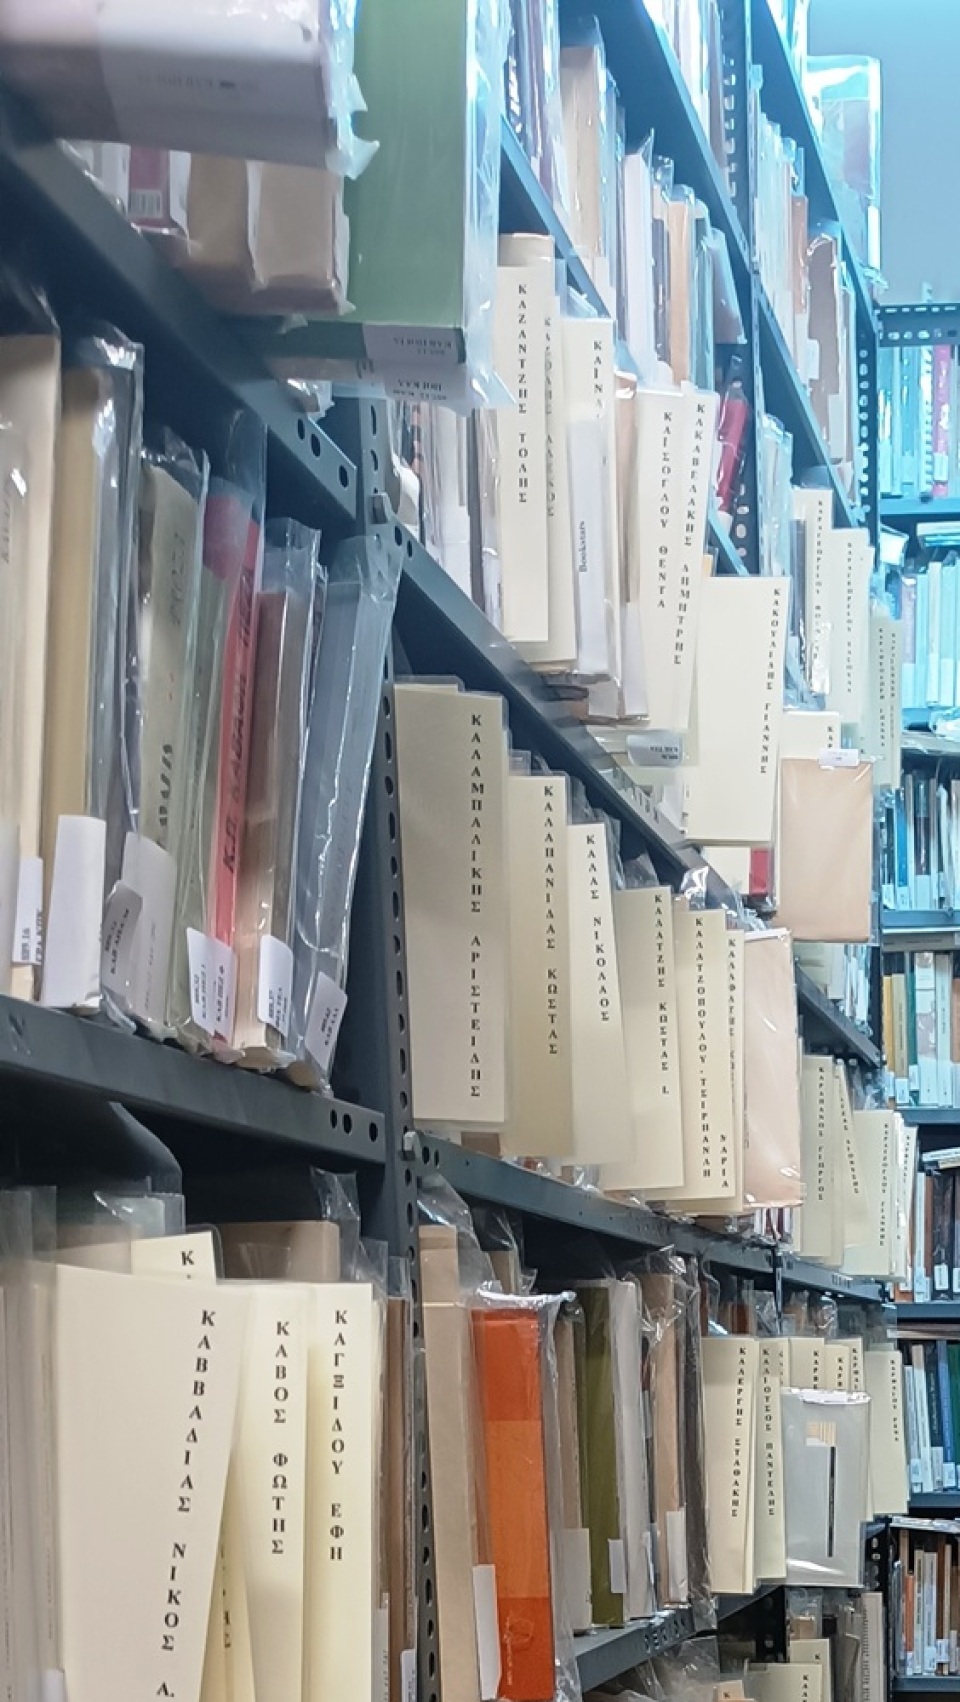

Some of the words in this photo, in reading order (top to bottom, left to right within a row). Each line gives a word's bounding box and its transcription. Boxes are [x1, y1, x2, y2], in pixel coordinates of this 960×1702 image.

[470, 936, 481, 1098] ΑΡΙΣΤΕΙΔΗΣ
[547, 969, 558, 1055] ΚΩΣΤΑΣ
[178, 1311, 216, 1513] ΚΑΒΒΑΔΙΑΣ
[274, 1321, 290, 1424] ΚΑΒΟΣ
[272, 1453, 288, 1554] ΦΩΤΗΣ
[330, 1503, 345, 1560] ΕΦΗ
[162, 1543, 186, 1651] ΝΙΚΟΣ
